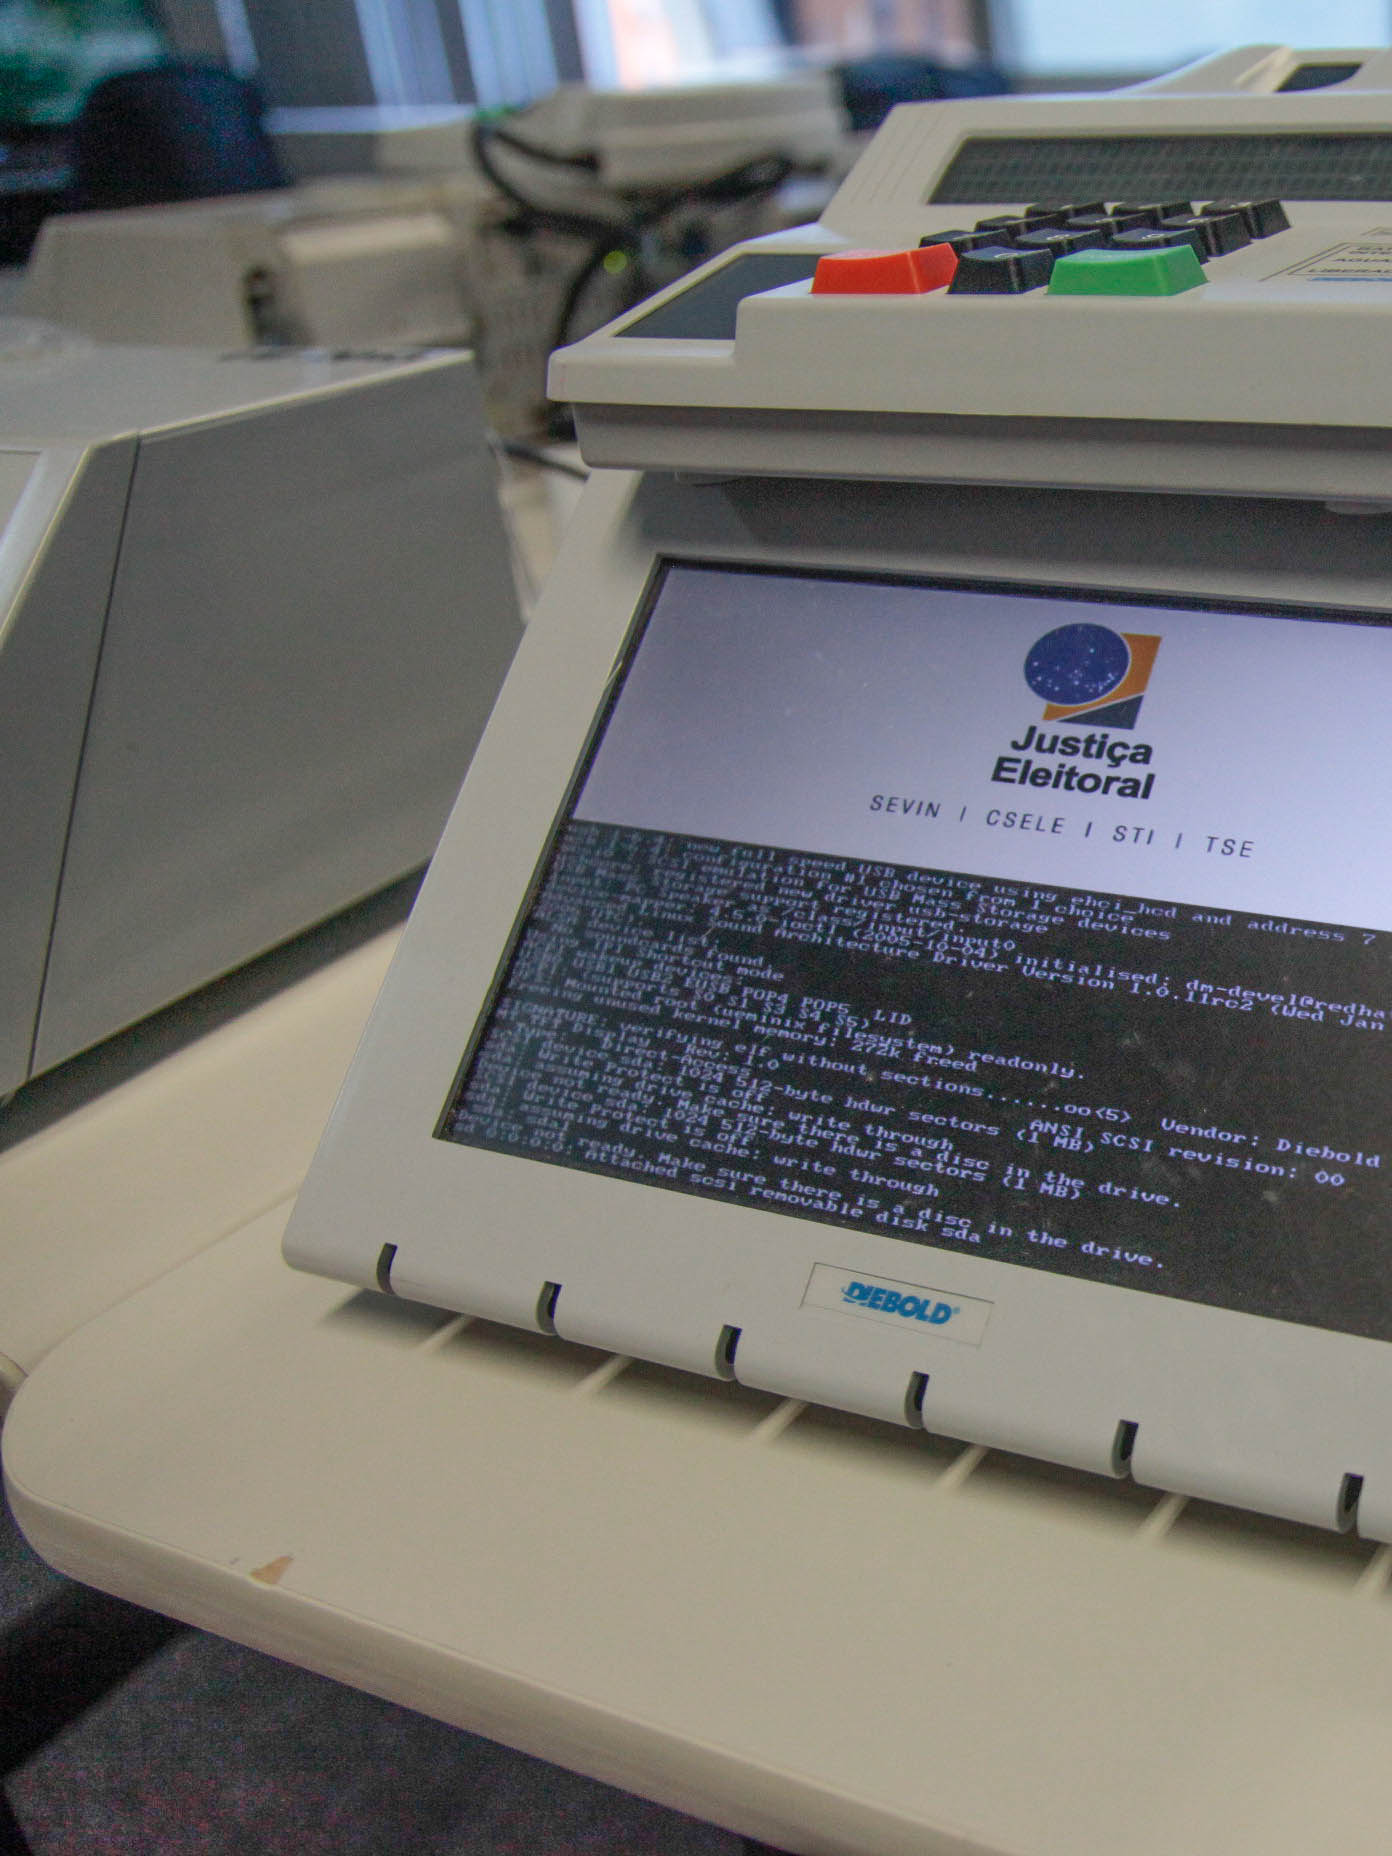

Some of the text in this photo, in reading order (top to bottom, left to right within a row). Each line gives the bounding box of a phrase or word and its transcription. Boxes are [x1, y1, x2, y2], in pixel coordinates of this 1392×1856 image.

[1011, 725, 1154, 768] Justiça
[990, 756, 1155, 799] Eleitoral
[869, 794, 941, 818] SEVIN
[986, 809, 1065, 834] CSELE
[1112, 825, 1154, 845] STI
[1206, 836, 1254, 858] TSE
[826, 892, 900, 911] driver
[910, 906, 1051, 934] usb-storage
[834, 906, 965, 932] registered.
[860, 865, 899, 879] USB
[909, 872, 985, 891] device
[996, 886, 1061, 903] using
[1073, 896, 1180, 918] ehci_hcd
[1192, 913, 1235, 926] and
[1247, 920, 1346, 941] address
[1359, 934, 1375, 945] 7
[865, 887, 904, 901] USB
[914, 894, 965, 910] Mass
[976, 903, 1067, 925] Storage
[1079, 918, 1173, 940] devices
[881, 880, 956, 898] chosen
[967, 891, 1019, 907] from
[1032, 900, 1044, 910] 1
[1056, 905, 1136, 923] choice
[933, 952, 1011, 973] Driver
[1023, 966, 1116, 989] Version
[1129, 982, 1254, 1010] 1.0.11rc2
[1268, 1003, 1327, 1021] (Wed
[1338, 1014, 1385, 1030] Jan
[1014, 953, 1169, 986] initialised:
[798, 1008, 824, 1021] S4
[834, 1015, 871, 1031] S5)
[875, 1010, 914, 1025] LID
[754, 1025, 837, 1046] memory:
[851, 1040, 903, 1058] 272k
[914, 1051, 980, 1072] freed
[969, 1051, 1083, 1078] readonly.
[732, 1089, 770, 1103] off
[735, 1077, 834, 1104] 512-byte
[845, 1097, 897, 1116] hdwr
[908, 1111, 1001, 1135] sectors
[1014, 1129, 1041, 1143] (1
[1054, 1136, 1095, 1155] MB)
[783, 1053, 871, 1076] without
[1161, 1119, 1258, 1146] Vendor:
[1276, 1139, 1382, 1168] Diebold
[716, 1132, 755, 1147] off
[788, 1112, 852, 1131] write
[863, 1124, 955, 1151] through
[1030, 1120, 1085, 1139] ANSI
[1098, 1132, 1154, 1152] SCSI
[1168, 1147, 1296, 1178] revision:
[1315, 1172, 1346, 1187] 00
[720, 1120, 819, 1148] 512-byte
[830, 1142, 882, 1161] hdwr
[894, 1156, 987, 1182] sectors
[1000, 1175, 1027, 1189] (1
[1040, 1183, 1081, 1202] MB)
[736, 1113, 786, 1130] sure
[797, 1123, 860, 1144] there
[873, 1138, 899, 1152] is
[910, 1147, 924, 1157] a
[936, 1150, 990, 1170] disc
[1004, 1163, 1031, 1178] in
[1043, 1171, 1086, 1189] the
[1099, 1182, 1180, 1207] drive.
[773, 1156, 837, 1176] write
[848, 1169, 940, 1197] through
[689, 1174, 738, 1191] scsi
[749, 1186, 863, 1218] removable
[875, 1211, 930, 1232] disk
[941, 1227, 983, 1243] sda
[716, 1168, 767, 1185] sure
[777, 1179, 842, 1201] there
[854, 1195, 880, 1209] is
[892, 1204, 906, 1214] a
[918, 1208, 973, 1228] disc
[986, 1222, 1013, 1237] in
[1026, 1230, 1069, 1248] the
[1082, 1242, 1164, 1268] drive.
[841, 1280, 952, 1325] DIEBOLD
